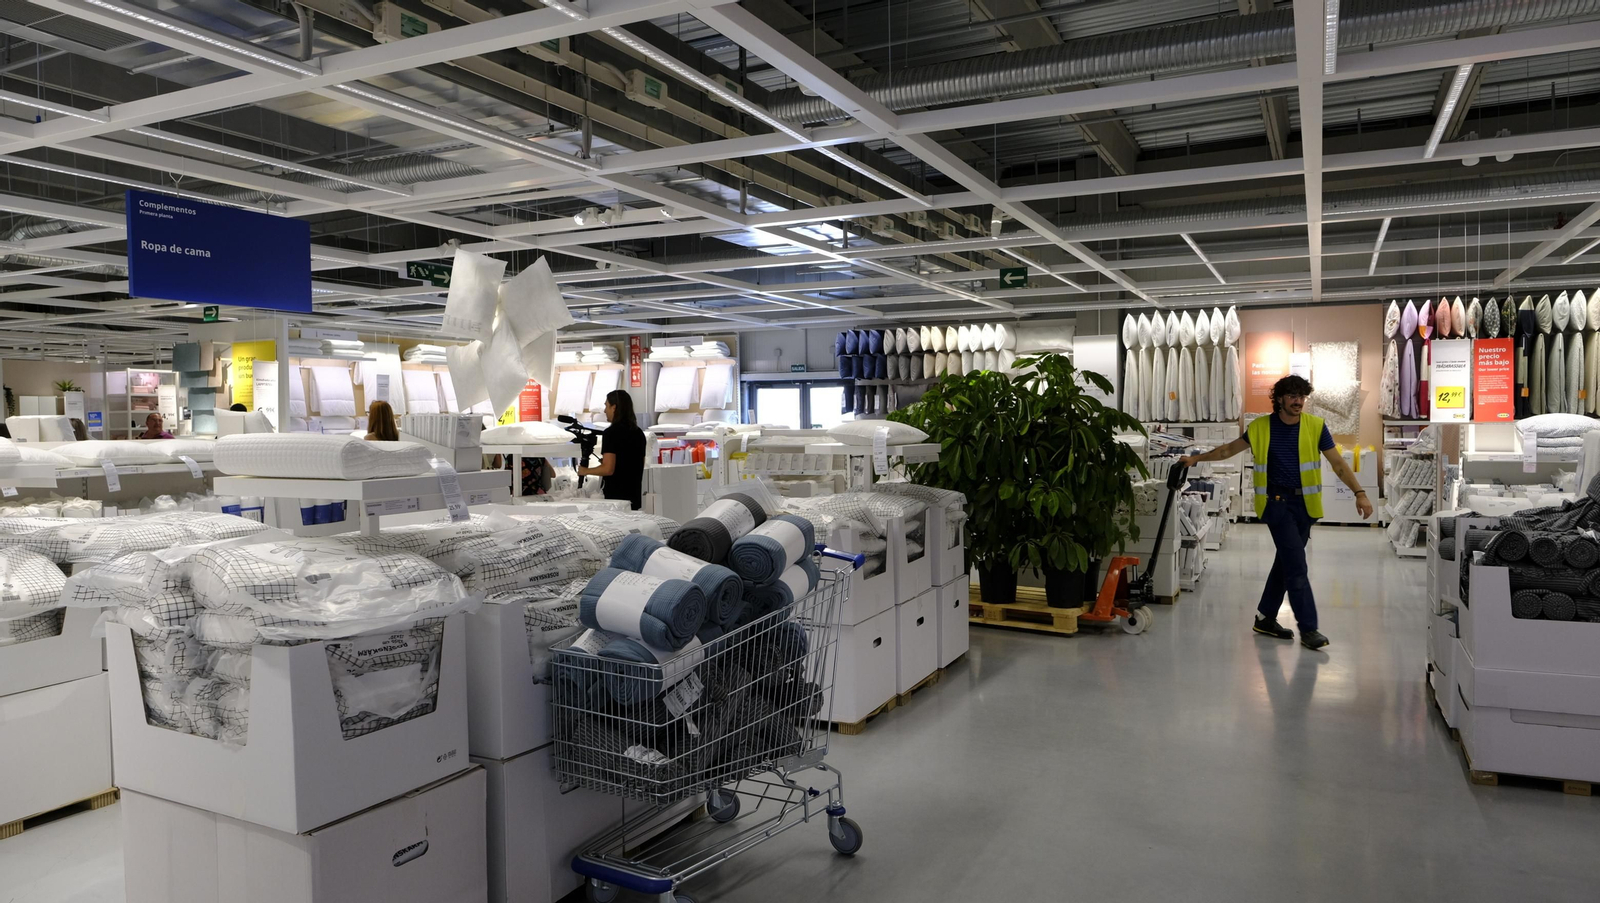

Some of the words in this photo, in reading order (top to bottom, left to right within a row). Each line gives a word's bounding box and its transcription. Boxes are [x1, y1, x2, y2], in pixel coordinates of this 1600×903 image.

[139, 200, 197, 216] Complementos
[139, 209, 158, 217] Primera
[158, 212, 174, 220] planta
[141, 240, 167, 253] Ropa
[169, 244, 182, 254] de
[184, 248, 211, 258] cama
[1478, 353, 1500, 361] precio
